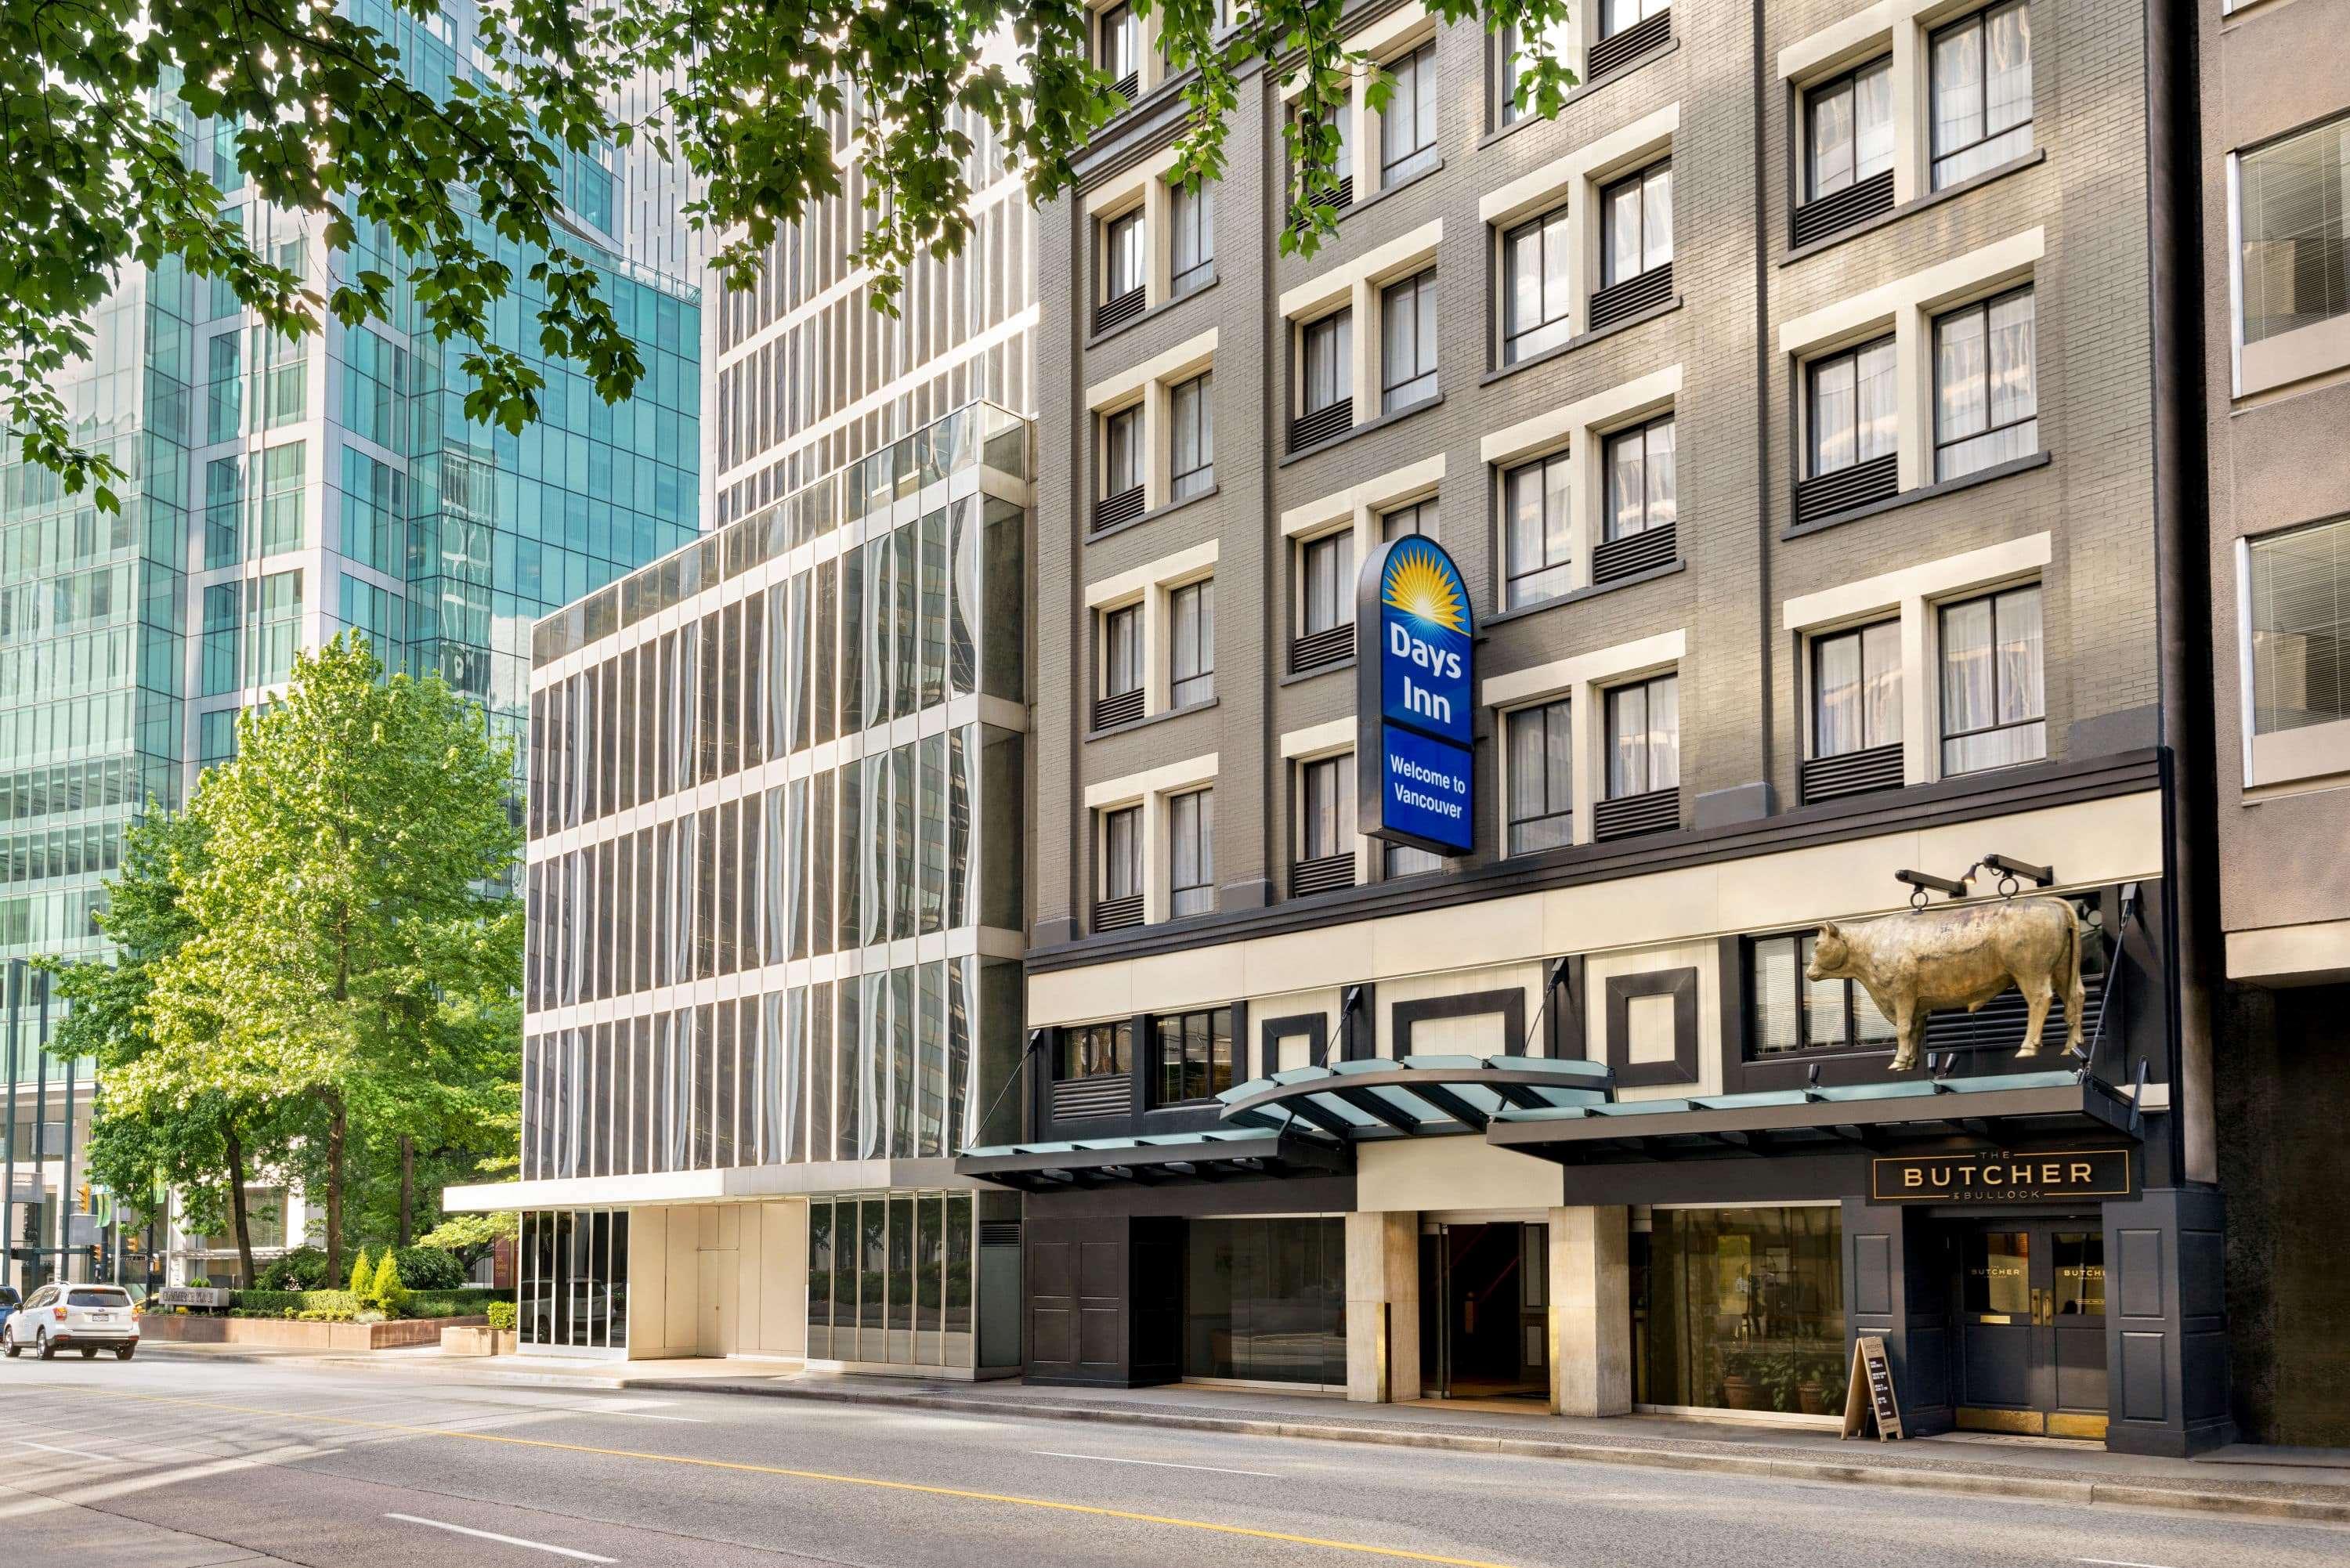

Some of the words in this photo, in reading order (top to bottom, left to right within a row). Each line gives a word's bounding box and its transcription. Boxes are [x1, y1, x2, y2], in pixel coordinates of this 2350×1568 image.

[1390, 621, 1462, 679] Days
[1404, 675, 1451, 724] Inn
[1390, 753, 1450, 789] Welcome
[1453, 775, 1466, 794] to
[1394, 782, 1462, 819] Vancouver
[1904, 1163, 2092, 1187] BUTCHER
[1979, 1151, 2011, 1160] THE
